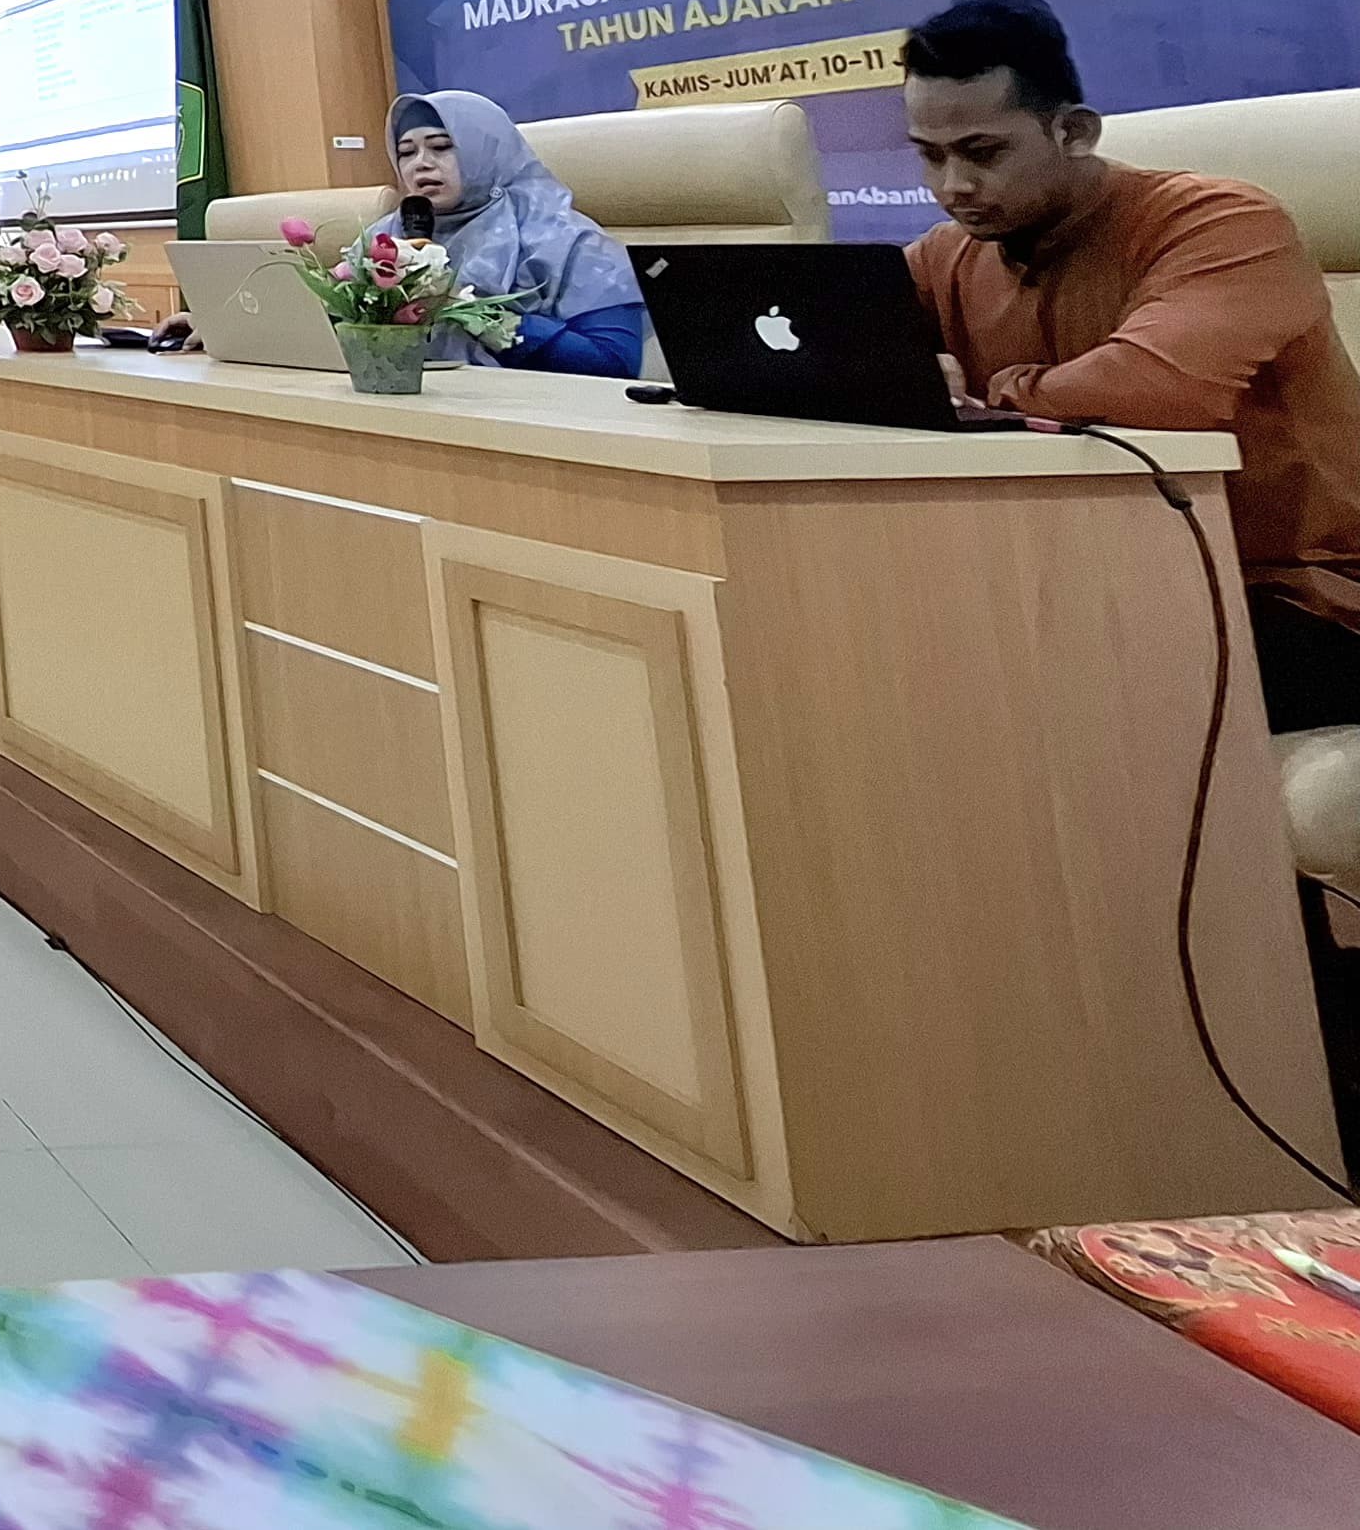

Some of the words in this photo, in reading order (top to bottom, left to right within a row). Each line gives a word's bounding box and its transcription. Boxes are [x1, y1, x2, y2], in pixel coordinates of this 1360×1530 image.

[557, 3, 674, 52] TAHUN
[644, 60, 818, 99] KAMIS-JUM'AT,
[821, 49, 884, 76] 10-11
